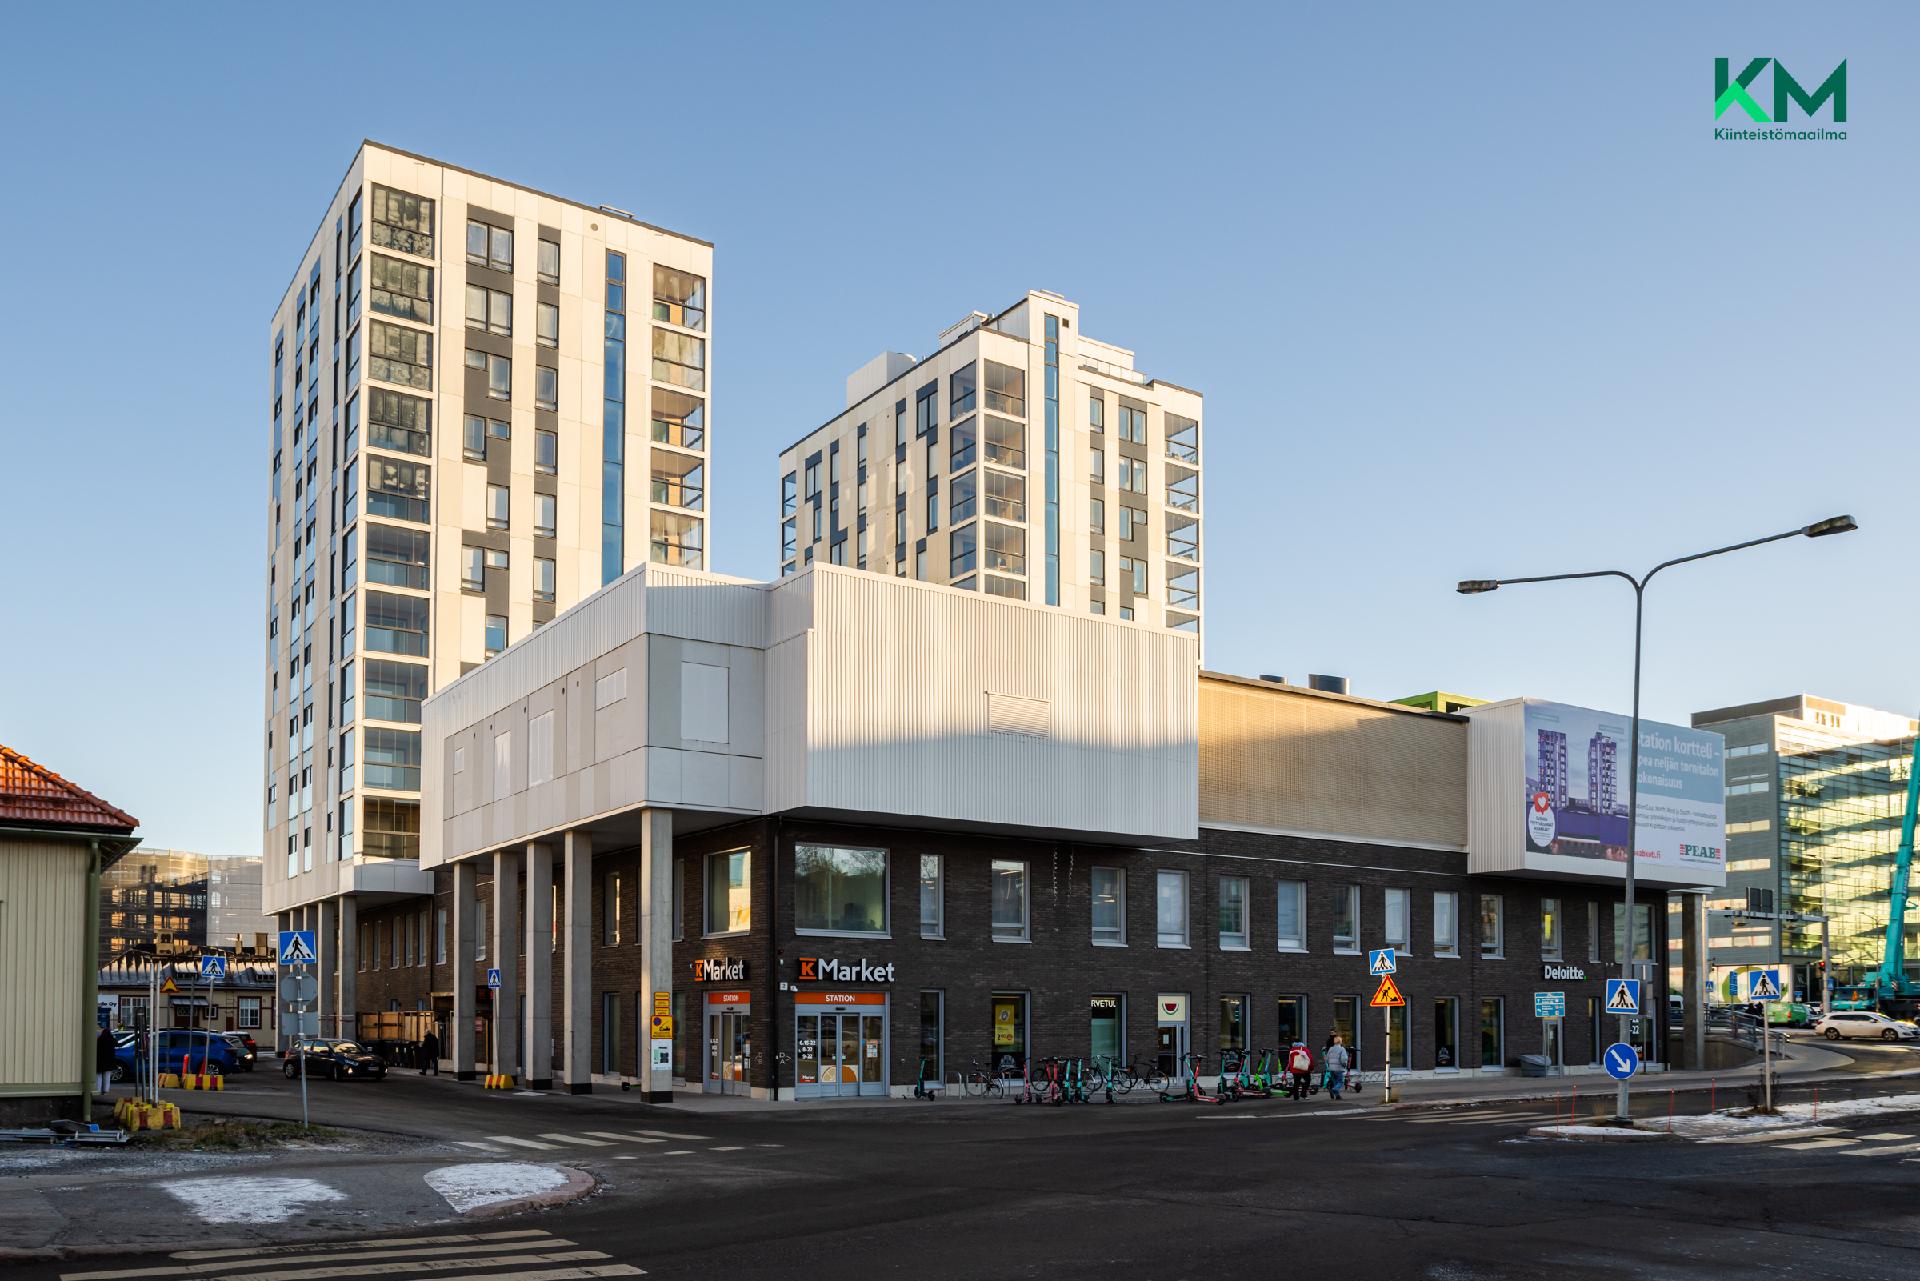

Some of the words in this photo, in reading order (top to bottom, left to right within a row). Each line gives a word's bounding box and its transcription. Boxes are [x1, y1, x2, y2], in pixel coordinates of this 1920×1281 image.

[1638, 732, 1671, 751] tation
[1673, 736, 1712, 759] kortteli
[1638, 755, 1653, 768] pea
[1637, 770, 1682, 789] okonaisuus
[1684, 844, 1716, 859] PEAB
[704, 957, 743, 980] Market
[818, 958, 895, 982] Market
[825, 994, 855, 1002] STATION
